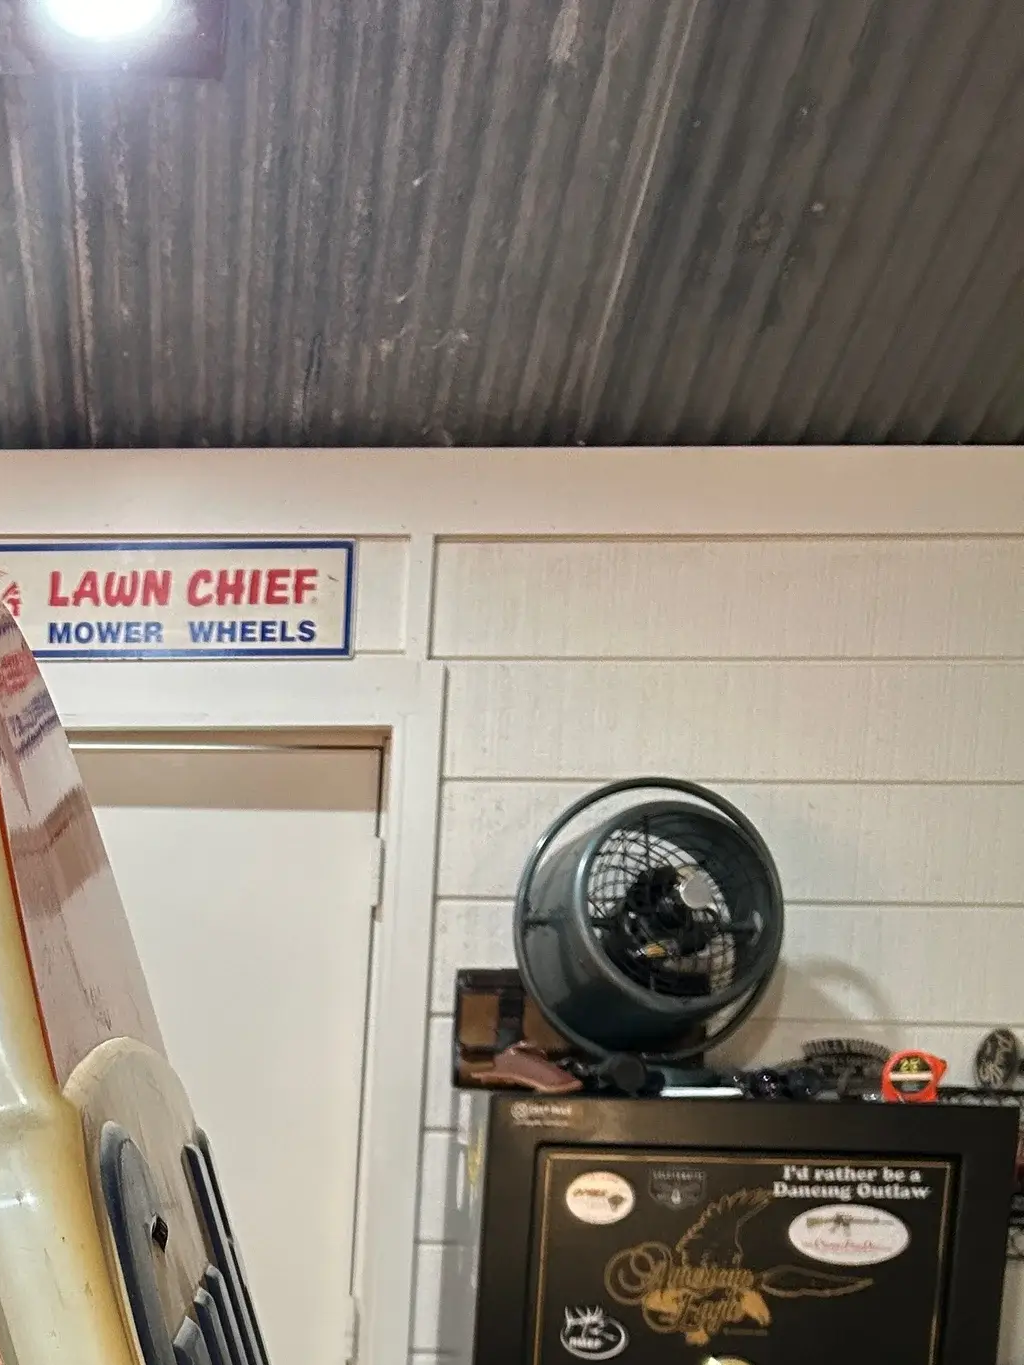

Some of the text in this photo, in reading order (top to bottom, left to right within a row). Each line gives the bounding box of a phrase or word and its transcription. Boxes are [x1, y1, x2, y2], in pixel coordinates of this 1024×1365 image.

[47, 568, 319, 607] LAWN CHIEF
[47, 619, 317, 644] MOWER WHEELS
[783, 1164, 921, 1183] I'd rather be a
[773, 1180, 932, 1201] Dancing Outlaw
